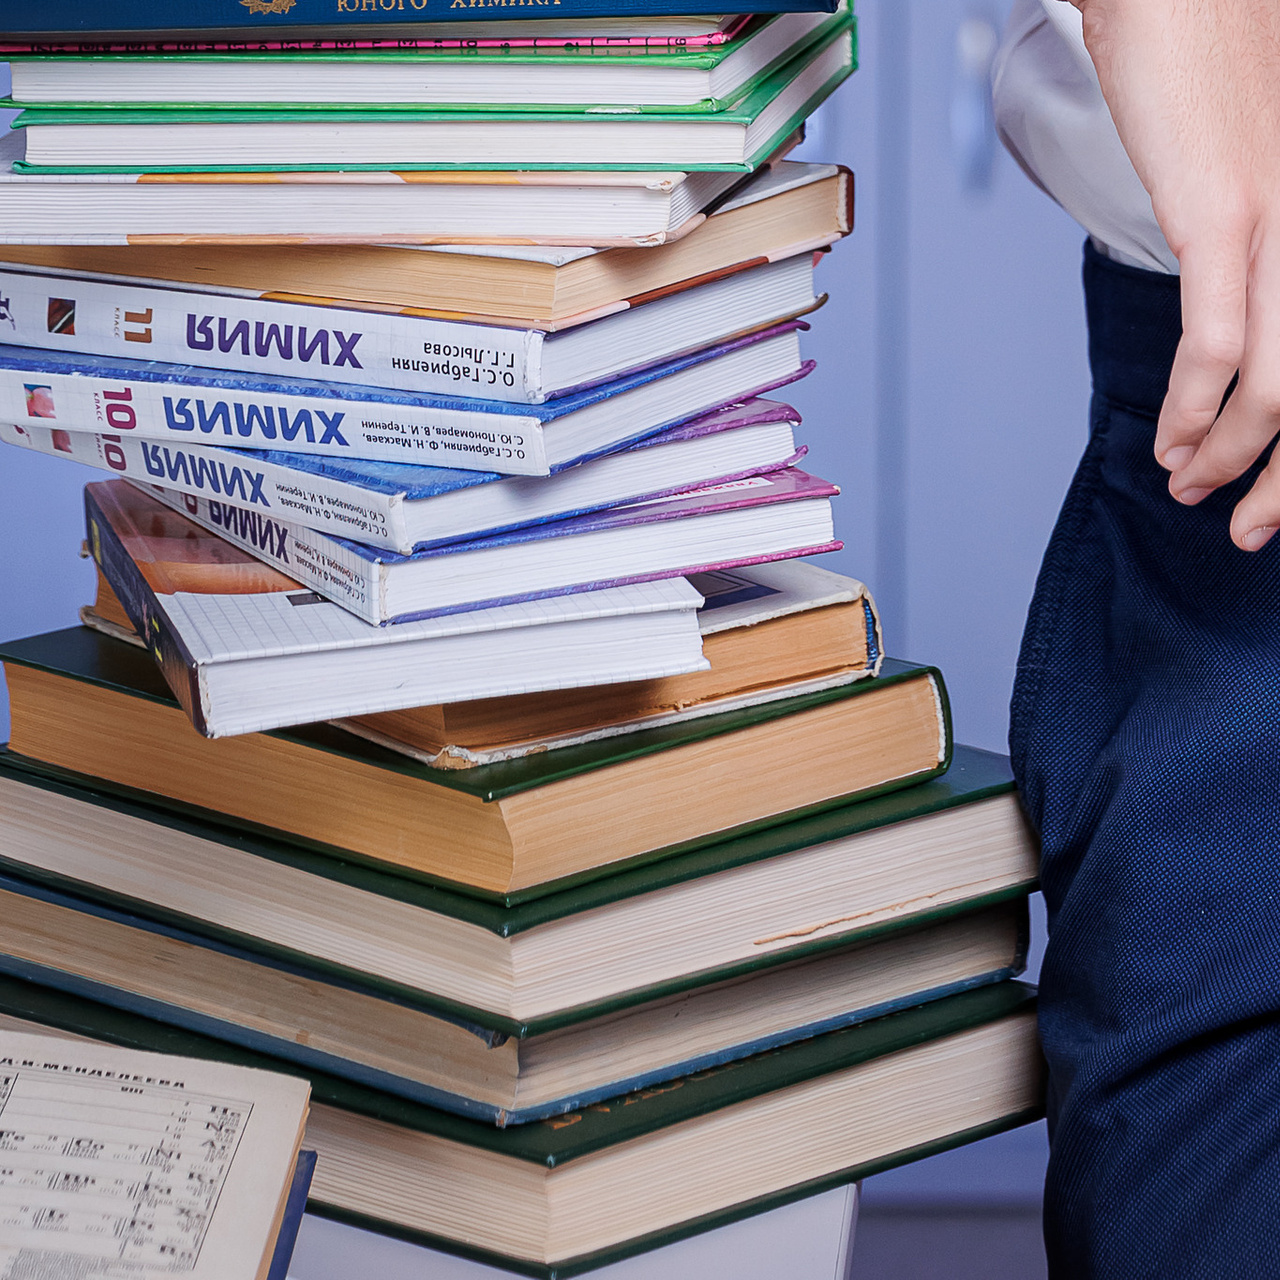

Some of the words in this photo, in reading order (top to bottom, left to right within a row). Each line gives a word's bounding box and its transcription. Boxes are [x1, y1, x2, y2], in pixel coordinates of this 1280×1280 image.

[124, 307, 153, 344] 11
[186, 313, 364, 370] ХИМИЯ
[103, 387, 137, 430] 10
[162, 396, 350, 447] ХИМИЯ
[140, 440, 271, 508] ХИМИЯ
